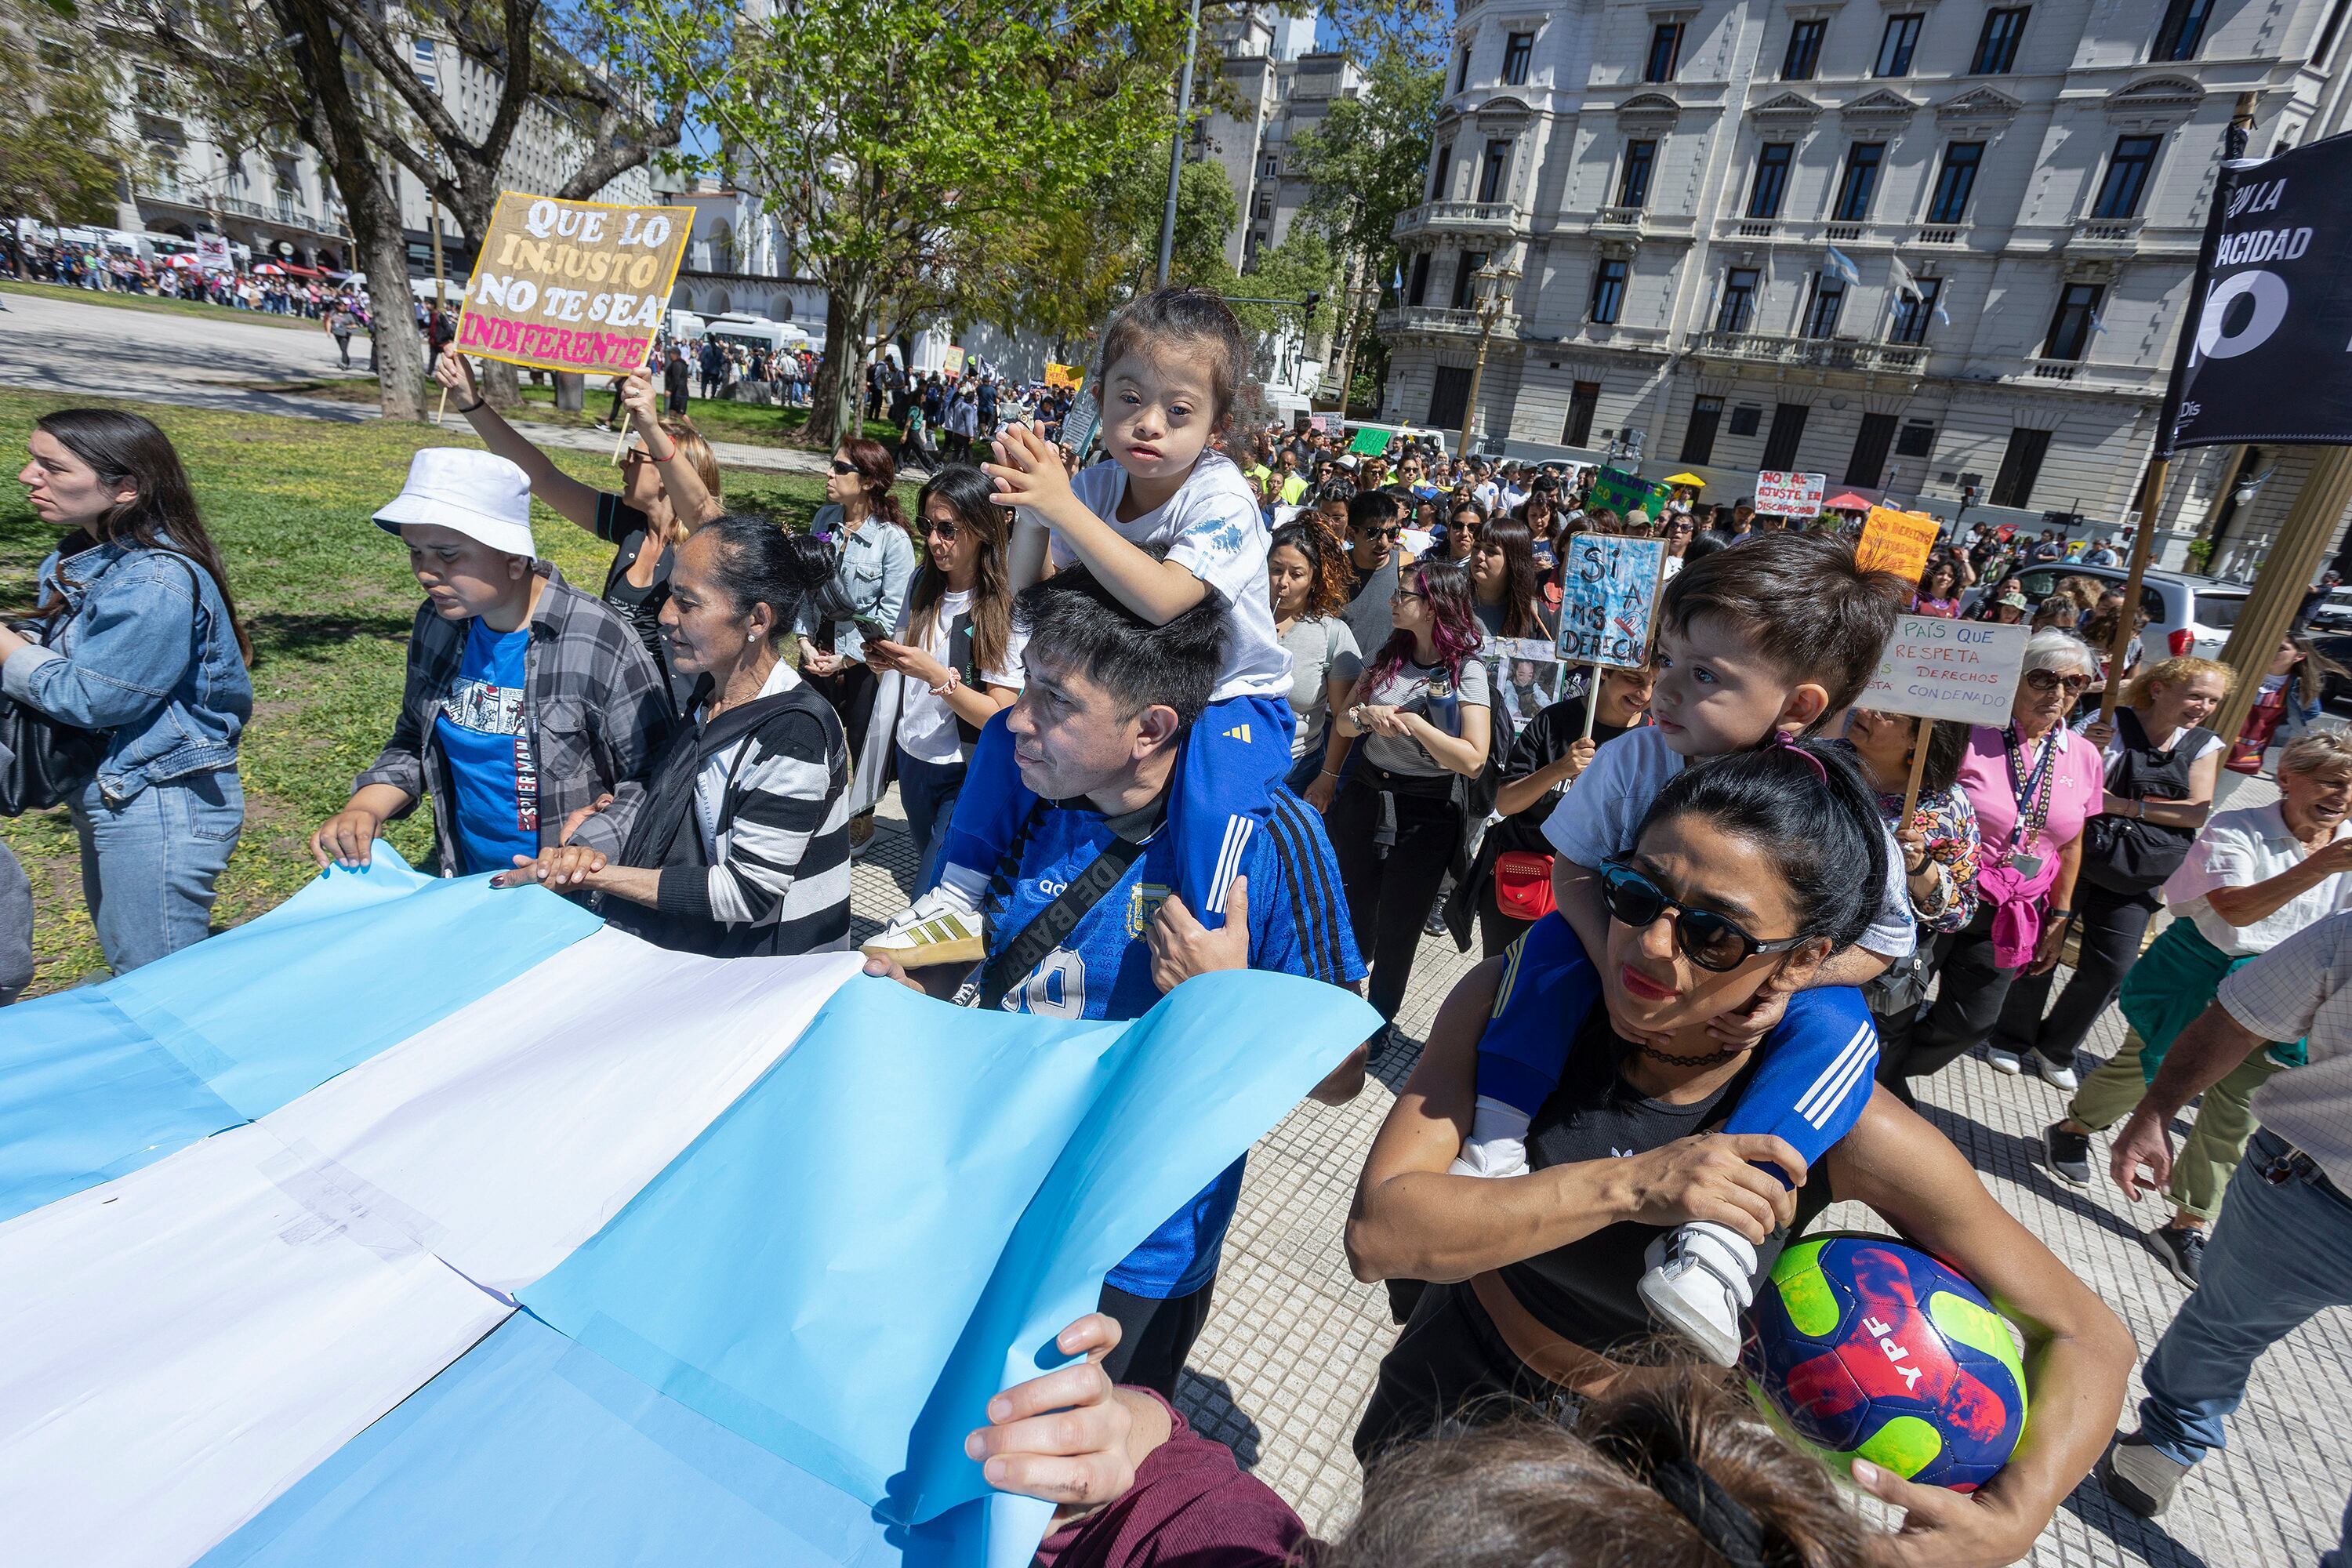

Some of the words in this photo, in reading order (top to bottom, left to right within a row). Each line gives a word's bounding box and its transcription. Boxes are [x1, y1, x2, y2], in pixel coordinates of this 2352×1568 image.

[2247, 178, 2288, 213] LA
[524, 200, 607, 242] QUE
[618, 212, 670, 248] LO
[496, 233, 658, 289] INJUSTO
[2215, 227, 2313, 268] ACIDAD
[475, 273, 537, 313] NO
[543, 287, 587, 321] TE
[588, 292, 659, 328] SEA
[2188, 270, 2288, 368] O
[459, 312, 649, 368] INDIFERENTE
[1759, 487, 1801, 499] AJUSTE
[1807, 491, 1821, 502] EN
[1762, 473, 1781, 484] NO
[1791, 473, 1806, 485] AL
[1622, 583, 1642, 609] A
[1905, 621, 1946, 638] PAÍS
[1957, 629, 1994, 644] QUE
[1896, 644, 1980, 663] RESPETA
[1917, 666, 1998, 684] DERECHOS
[1867, 681, 1894, 690] STA
[1907, 684, 2006, 707] CONDENADO
[703, 797, 715, 834] DARKNESS
[1073, 857, 1121, 907] DE
[1862, 1316, 1922, 1392] YPF
